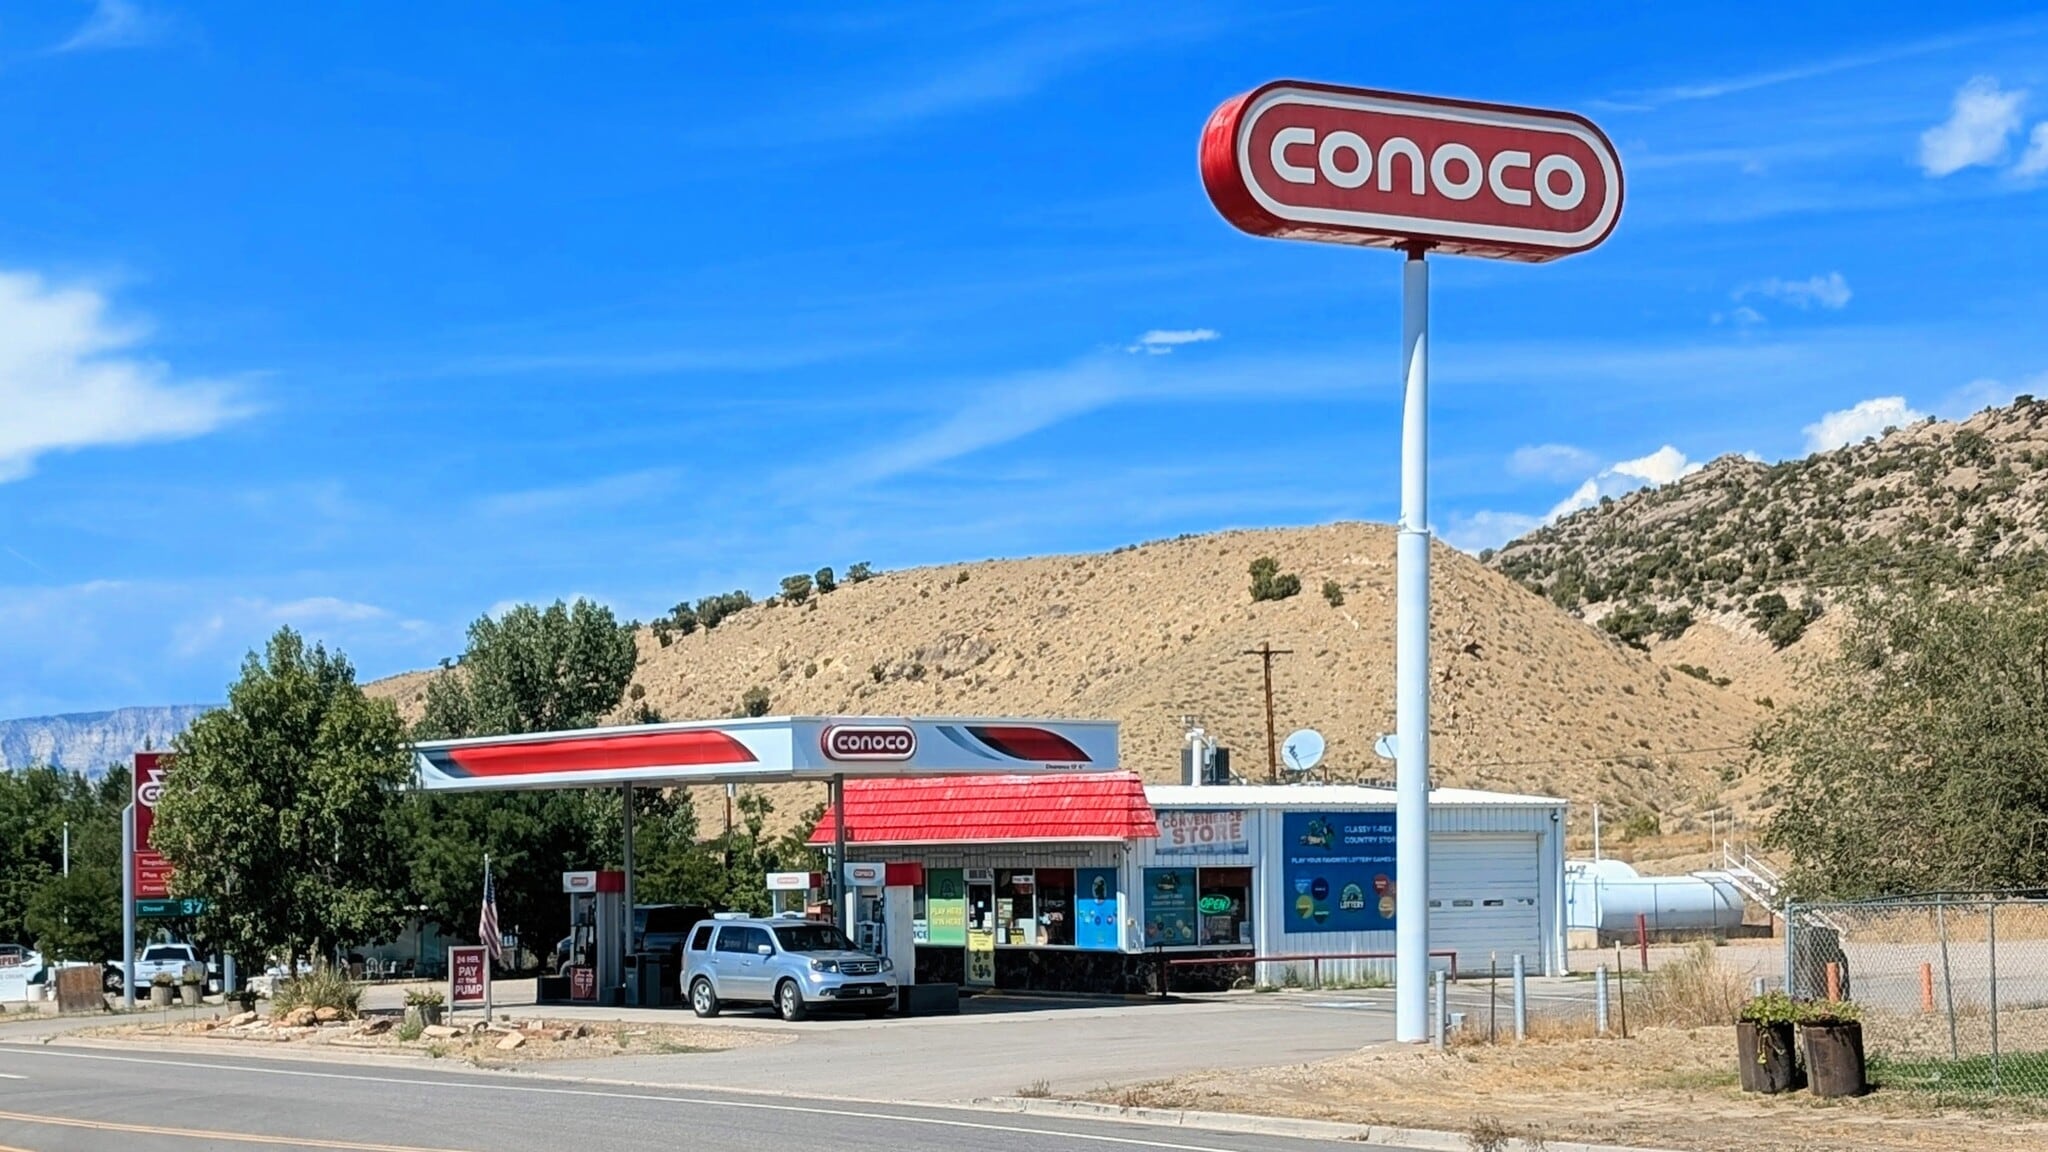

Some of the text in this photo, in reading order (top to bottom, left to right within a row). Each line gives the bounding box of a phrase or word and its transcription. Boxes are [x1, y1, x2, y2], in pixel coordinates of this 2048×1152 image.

[1270, 126, 1586, 211] CONOCO
[837, 735, 909, 750] CONOCO
[1162, 810, 1243, 829] CONVENIENCE
[1172, 822, 1242, 845] STORE
[1344, 825, 1370, 833] CLASSY
[1344, 836, 1377, 844] COUNTRY
[1200, 897, 1227, 911] OPEN
[1340, 901, 1364, 909] LOTTERY
[458, 966, 478, 977] PAY
[455, 984, 483, 996] PUMP
